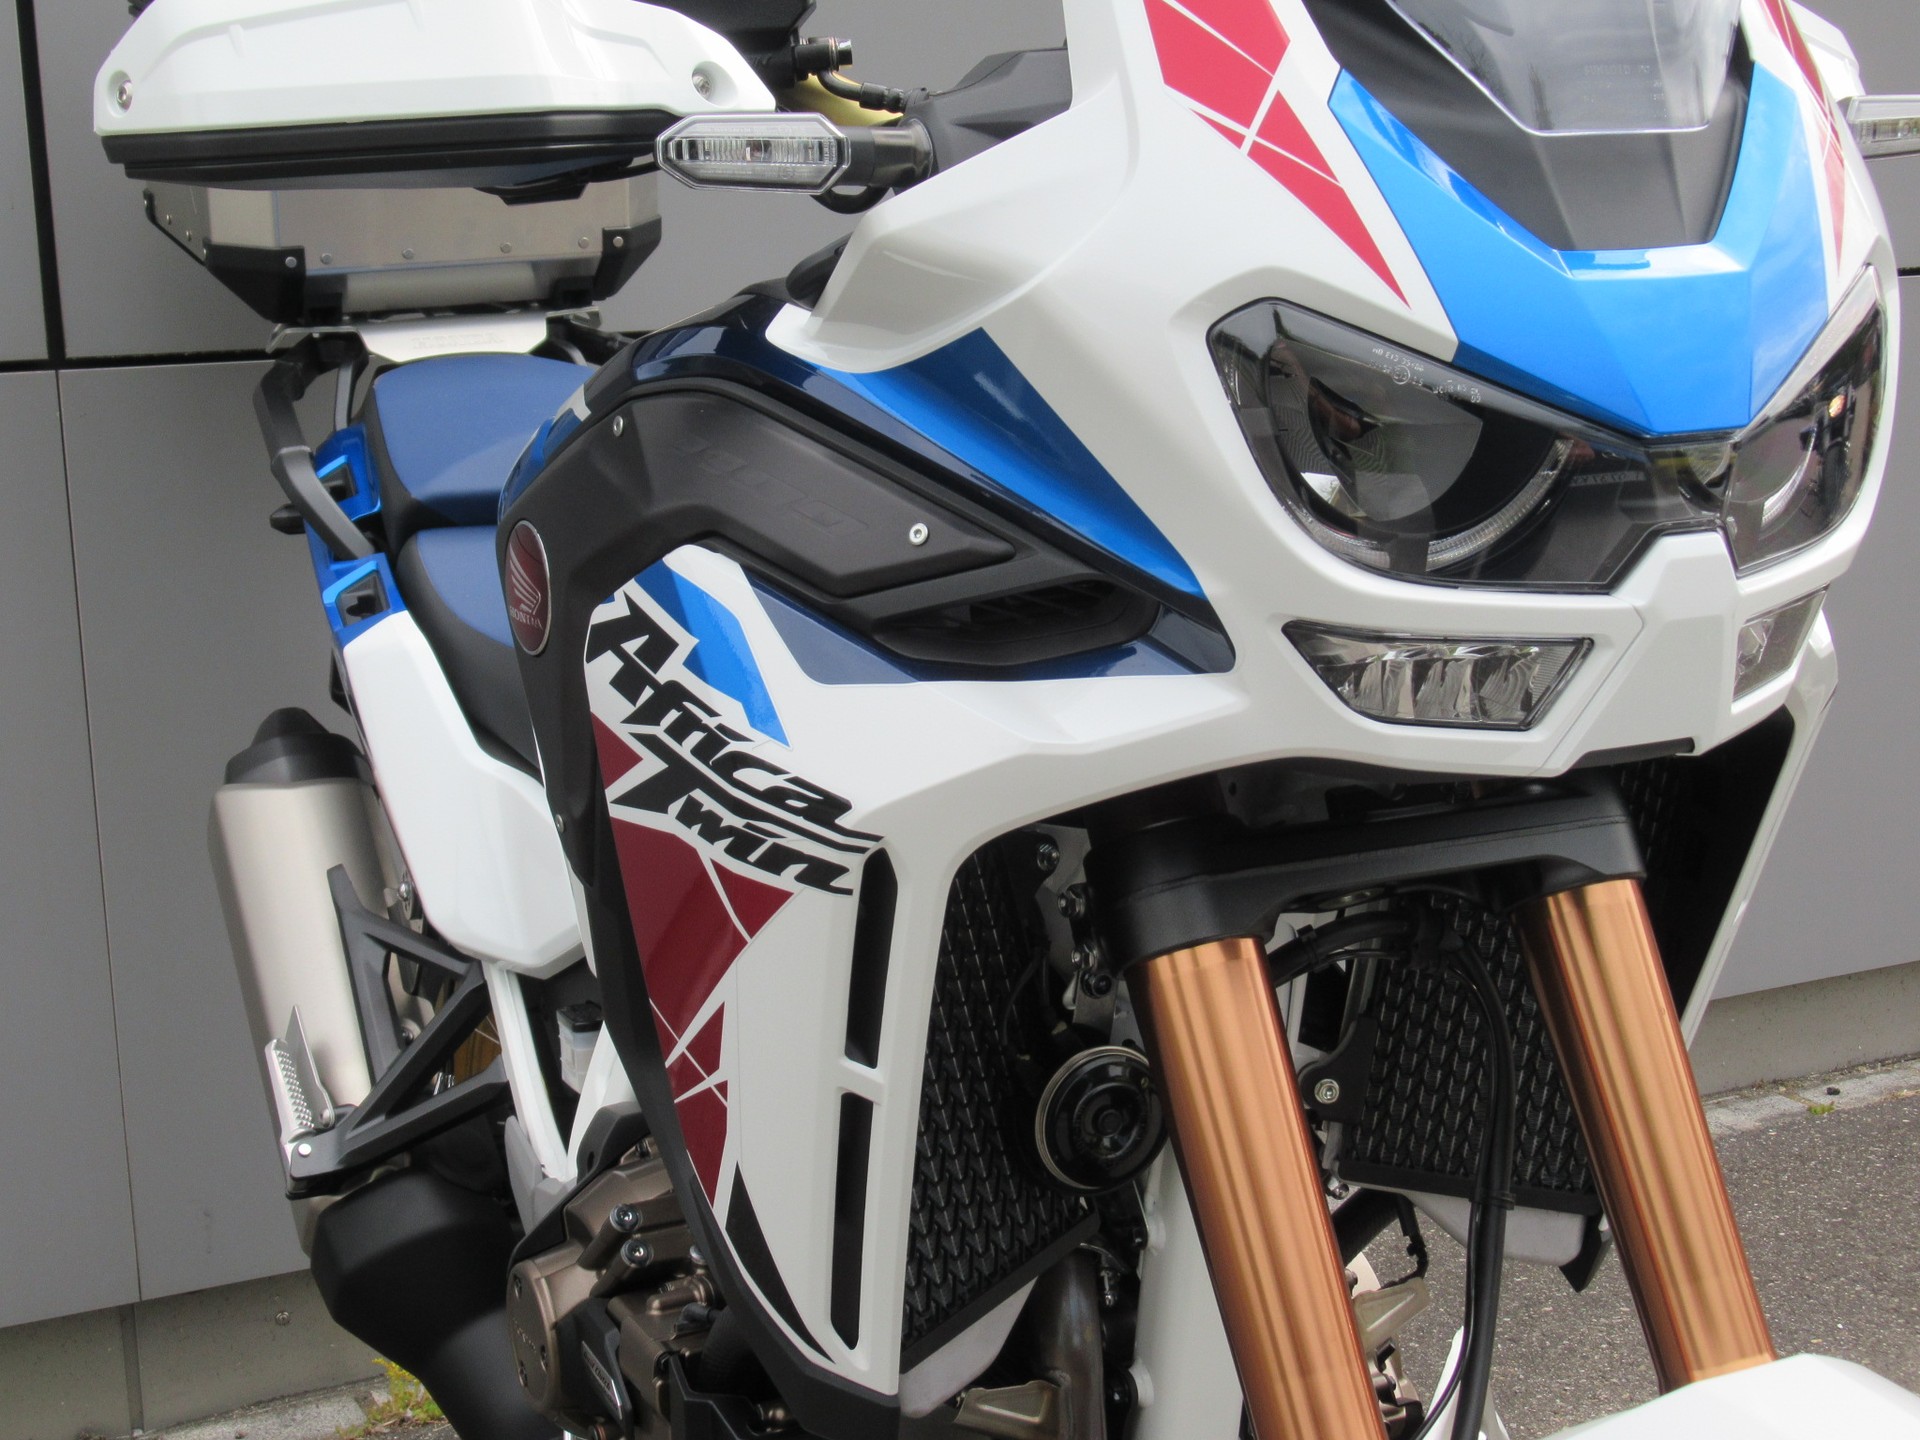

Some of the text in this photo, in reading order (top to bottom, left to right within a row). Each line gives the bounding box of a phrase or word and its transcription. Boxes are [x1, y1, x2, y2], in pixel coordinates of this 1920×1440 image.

[509, 606, 543, 630] HONDA
[586, 590, 884, 842] Africa
[609, 731, 871, 896] Twin
